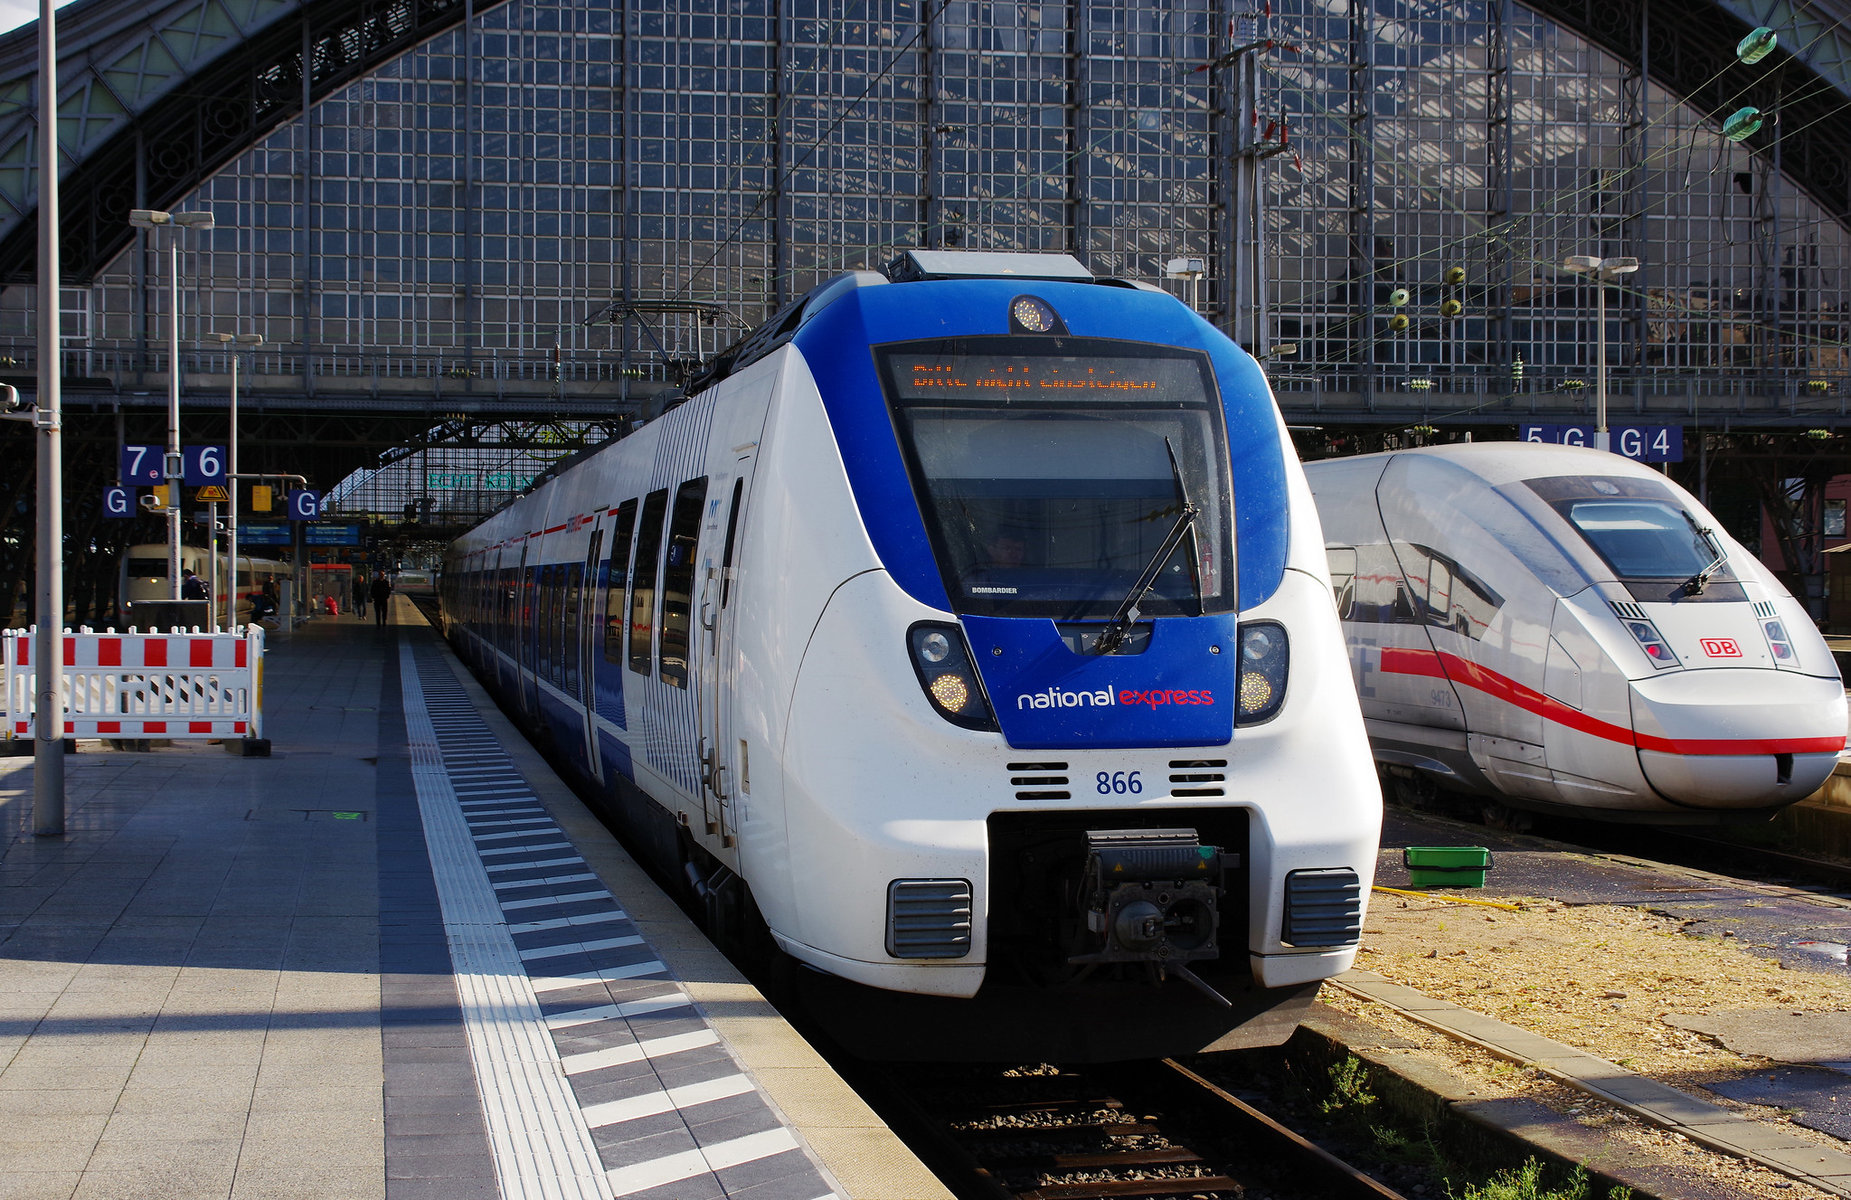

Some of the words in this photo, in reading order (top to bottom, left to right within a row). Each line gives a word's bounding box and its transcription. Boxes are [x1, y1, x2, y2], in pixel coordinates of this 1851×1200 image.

[1564, 428, 1584, 447] G
[1620, 428, 1641, 457] G
[1652, 428, 1670, 455] 4
[127, 446, 147, 475] 7
[199, 446, 220, 477] 6
[428, 473, 476, 489] ECHT
[107, 489, 126, 513] G
[297, 492, 316, 516] G
[1706, 641, 1737, 654] DB
[1017, 685, 1116, 709] national
[1119, 689, 1215, 711] express
[1096, 771, 1143, 794] 866
